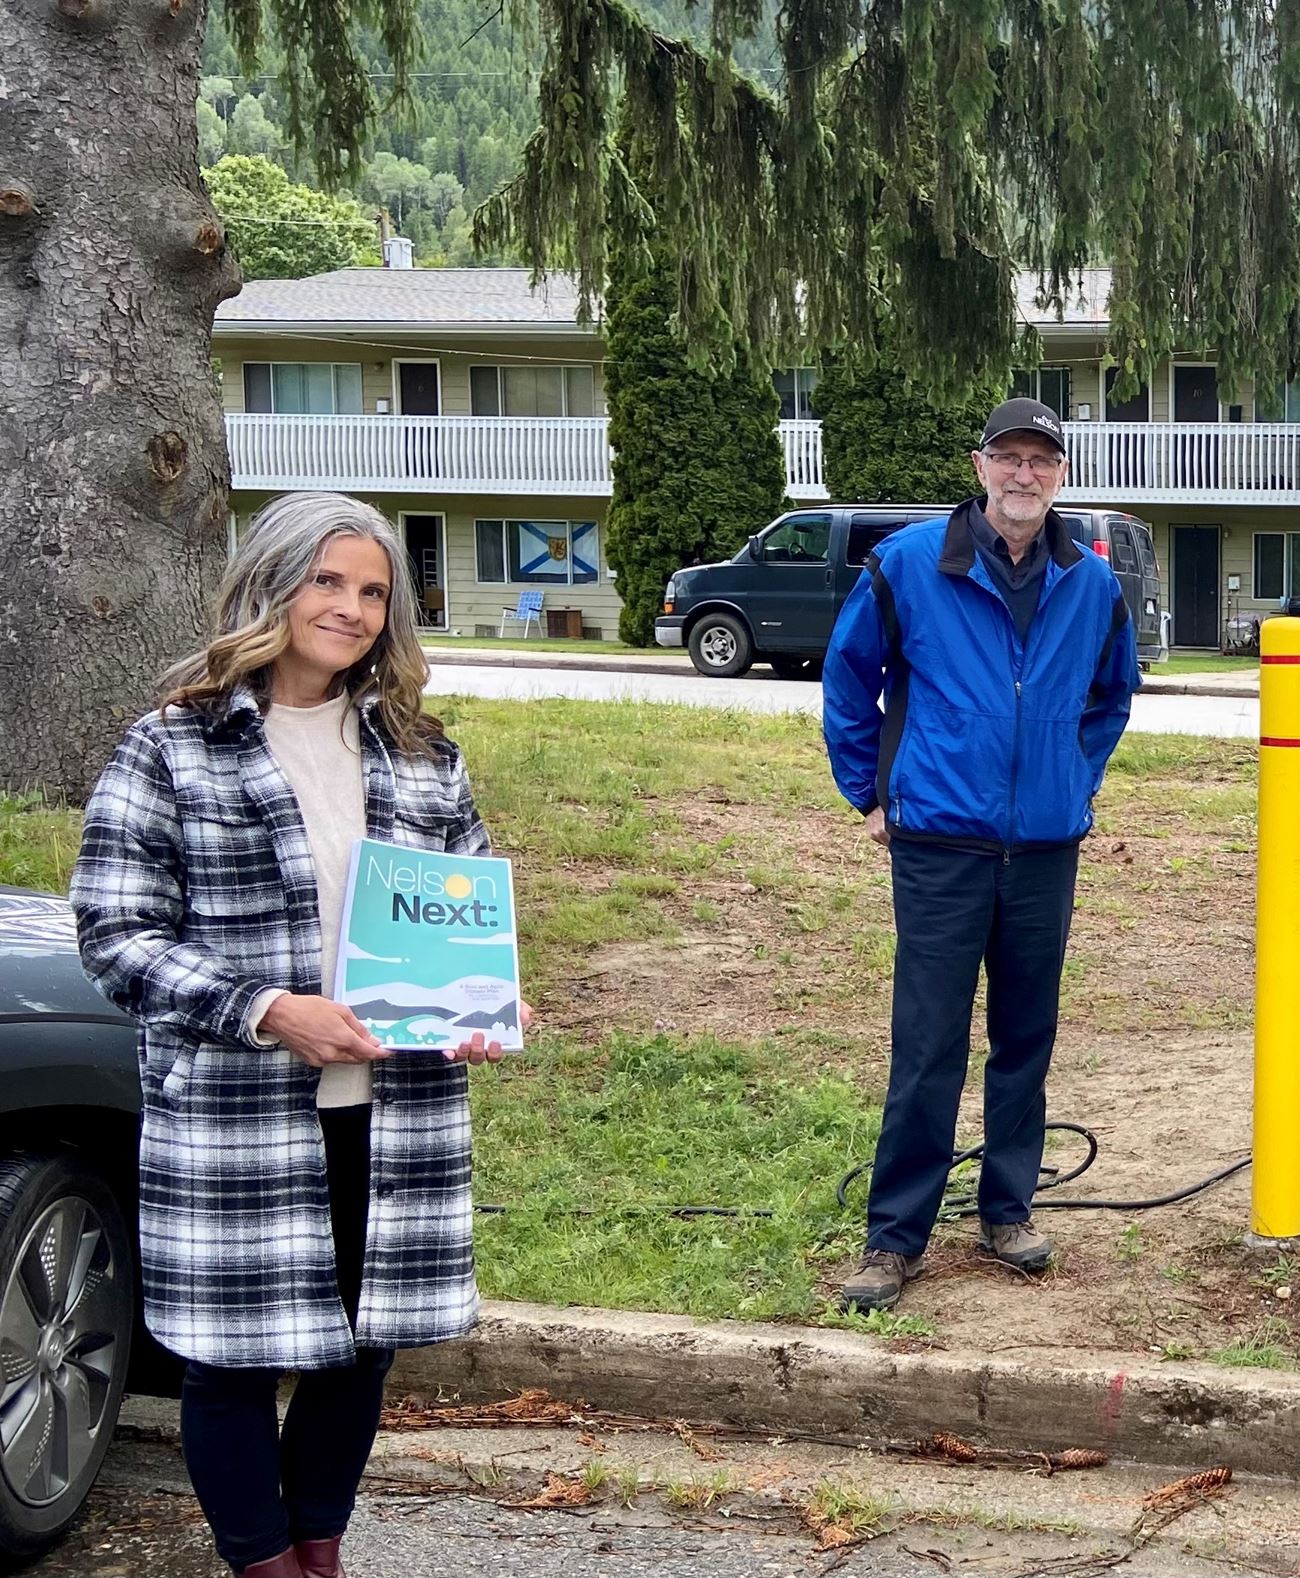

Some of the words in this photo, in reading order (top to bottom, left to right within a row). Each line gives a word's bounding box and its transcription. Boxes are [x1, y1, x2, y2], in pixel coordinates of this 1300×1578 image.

[1033, 416, 1060, 434] NELSON
[366, 855, 497, 899] Nelson
[391, 892, 499, 928] Next:
